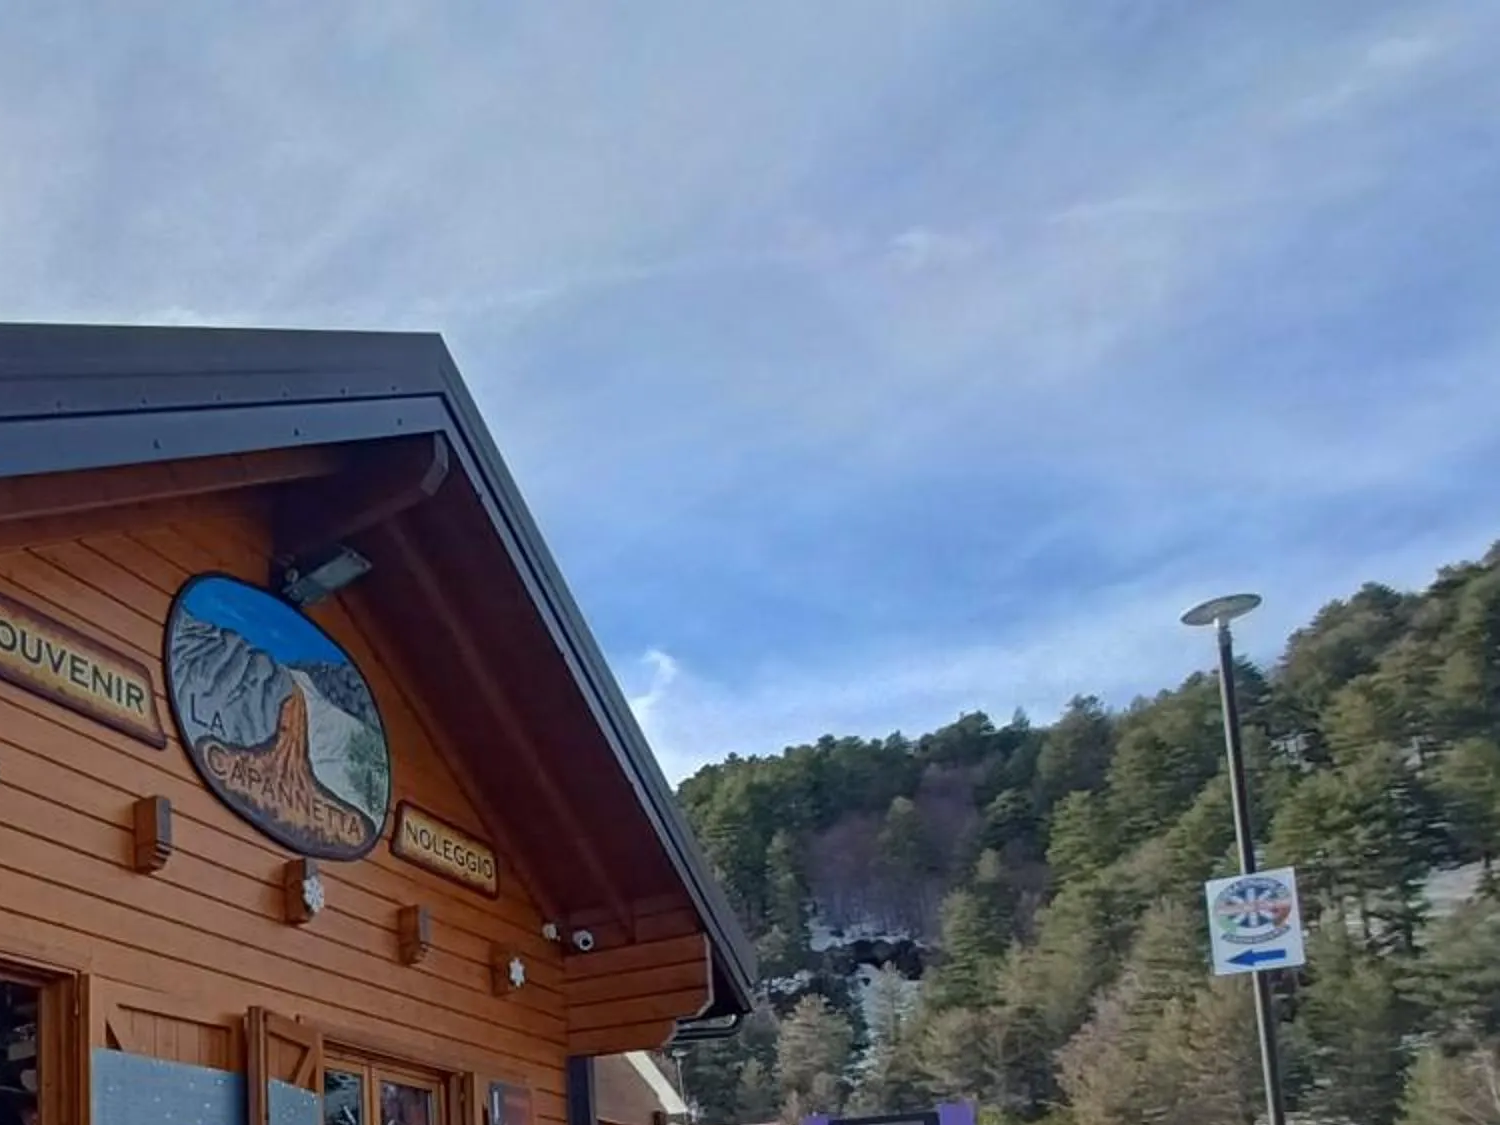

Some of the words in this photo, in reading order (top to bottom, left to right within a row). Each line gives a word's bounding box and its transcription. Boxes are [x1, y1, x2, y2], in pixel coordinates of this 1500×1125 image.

[190, 693, 227, 737] LA
[206, 743, 362, 841] CAPANNETTA
[405, 820, 493, 879] NOLEGGIO
